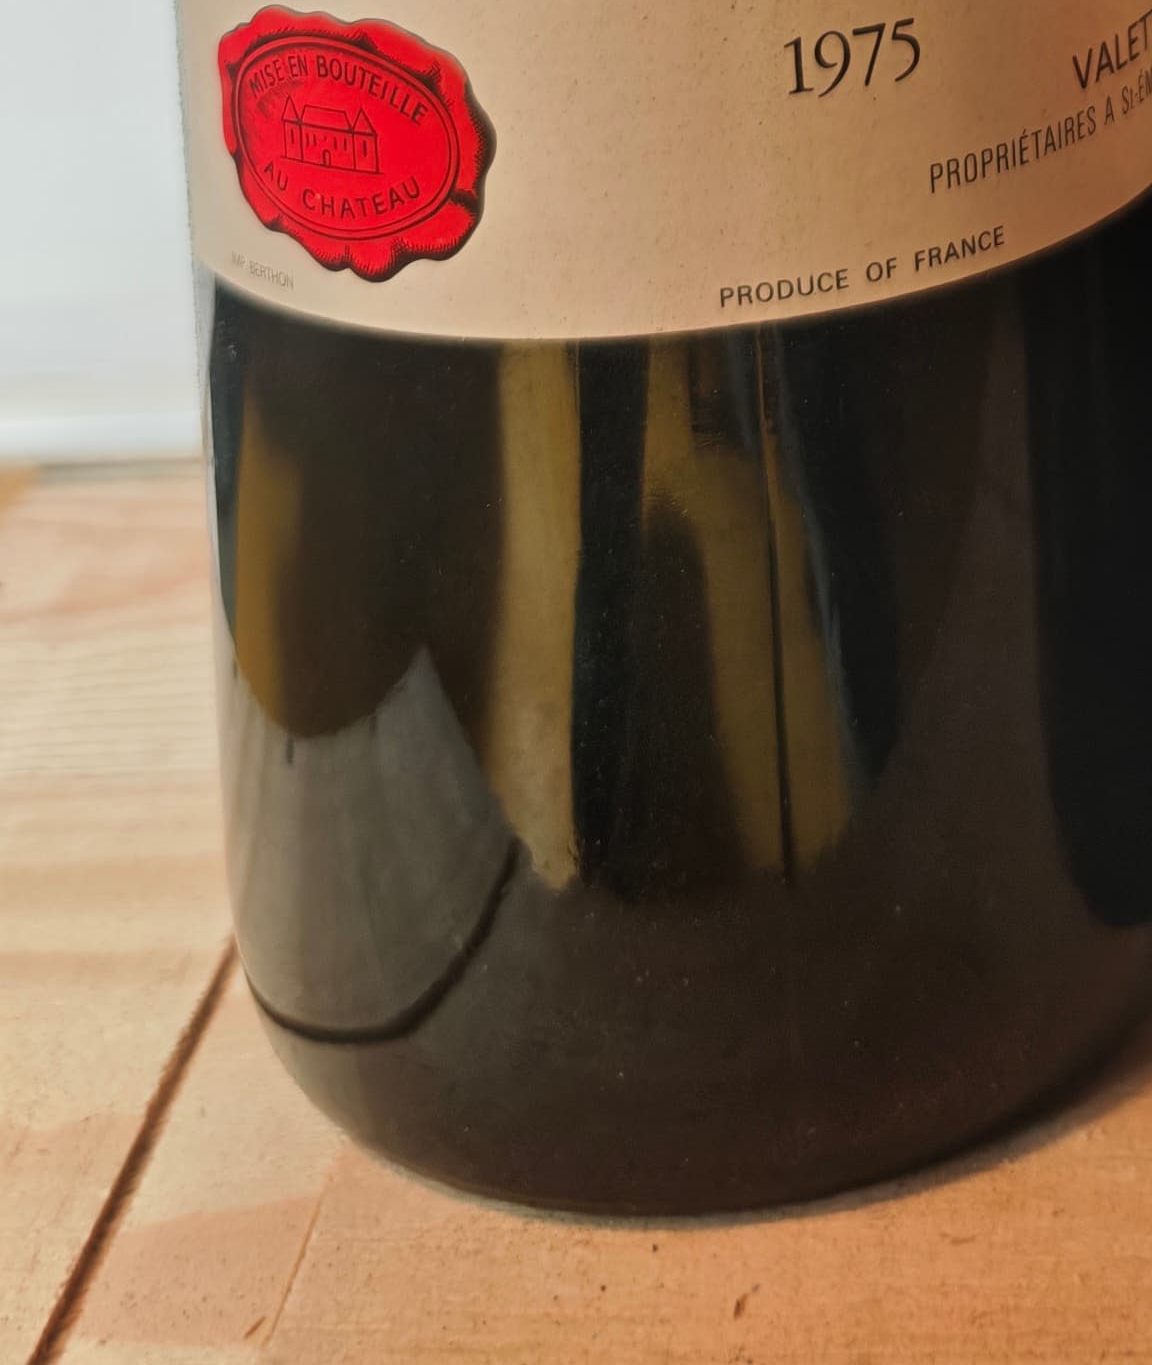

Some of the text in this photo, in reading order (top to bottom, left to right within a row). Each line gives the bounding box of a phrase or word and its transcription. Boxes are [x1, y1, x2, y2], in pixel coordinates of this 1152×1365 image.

[249, 54, 429, 127] MISE EN BOUTEILLE
[784, 18, 921, 98] 1975
[929, 105, 1097, 194] PROPRIÉTAIRES
[1104, 95, 1116, 126] A
[263, 160, 421, 220] AU CHATEAU
[719, 225, 1006, 308] PRODUCE OF FRANCE
